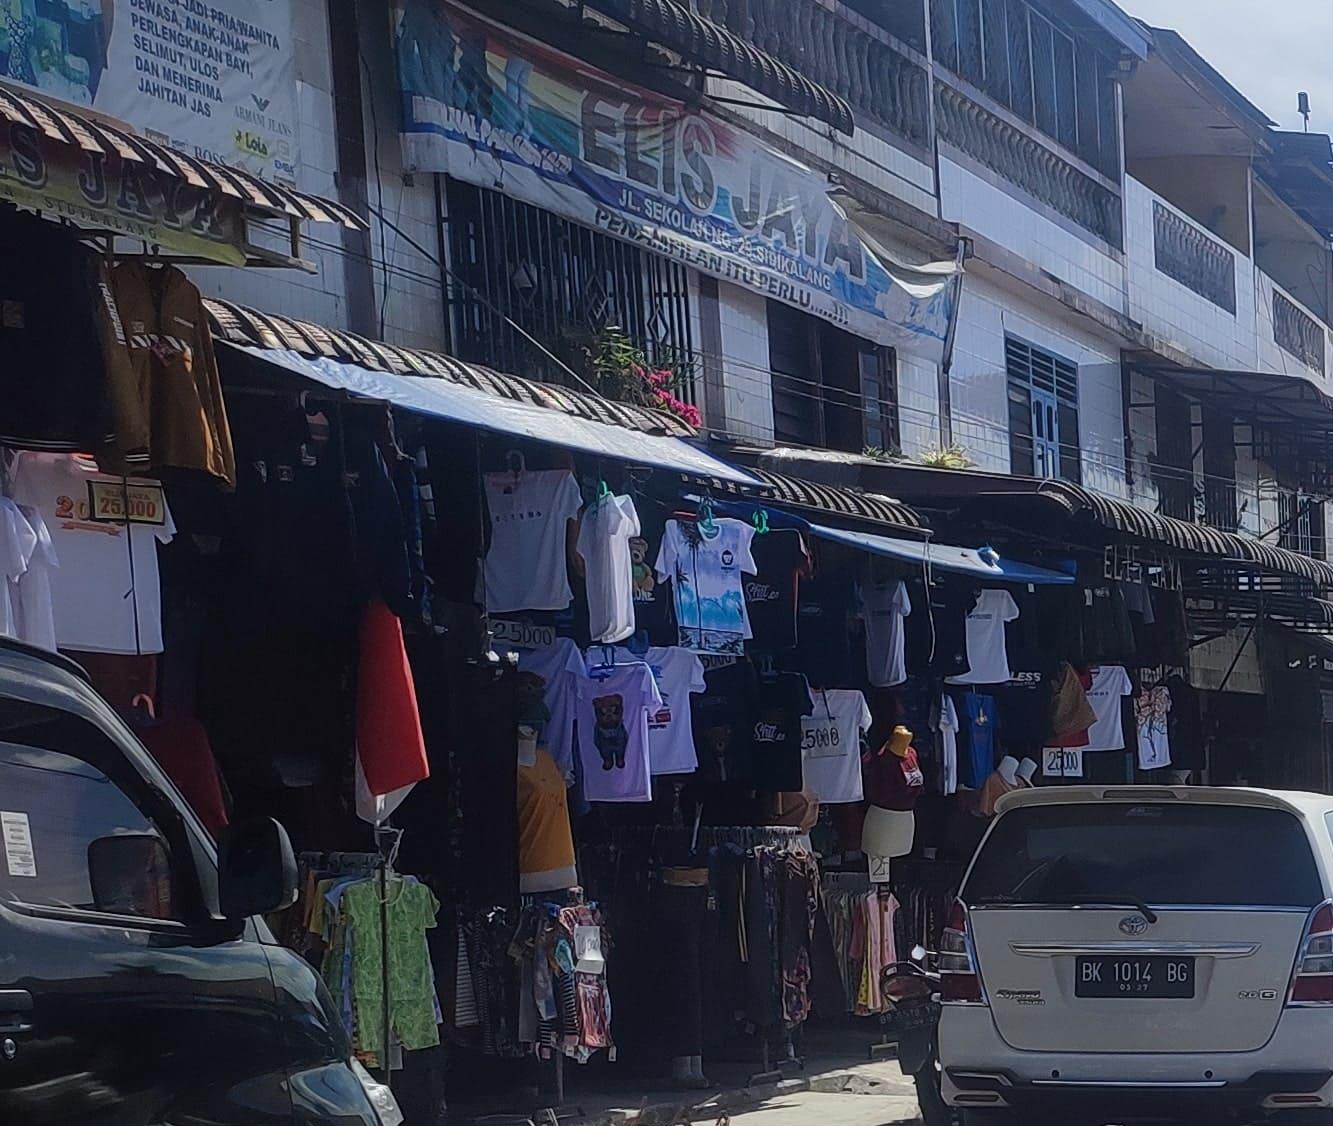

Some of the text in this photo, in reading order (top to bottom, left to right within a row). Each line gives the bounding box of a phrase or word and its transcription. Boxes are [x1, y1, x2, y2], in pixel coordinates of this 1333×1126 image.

[131, 12, 254, 80] PERLENGKAPAN BAYI,
[133, 33, 219, 81] SELIMUT, ULOS
[135, 56, 223, 103] DAN MENERIMA
[138, 77, 212, 118] JAHITAN JAS
[579, 90, 867, 285] ELIS JAYA
[619, 189, 641, 212] JL.
[493, 622, 553, 646] 25000
[1010, 671, 1042, 683] LESS
[1082, 962, 1188, 982] BK 1014 BG
